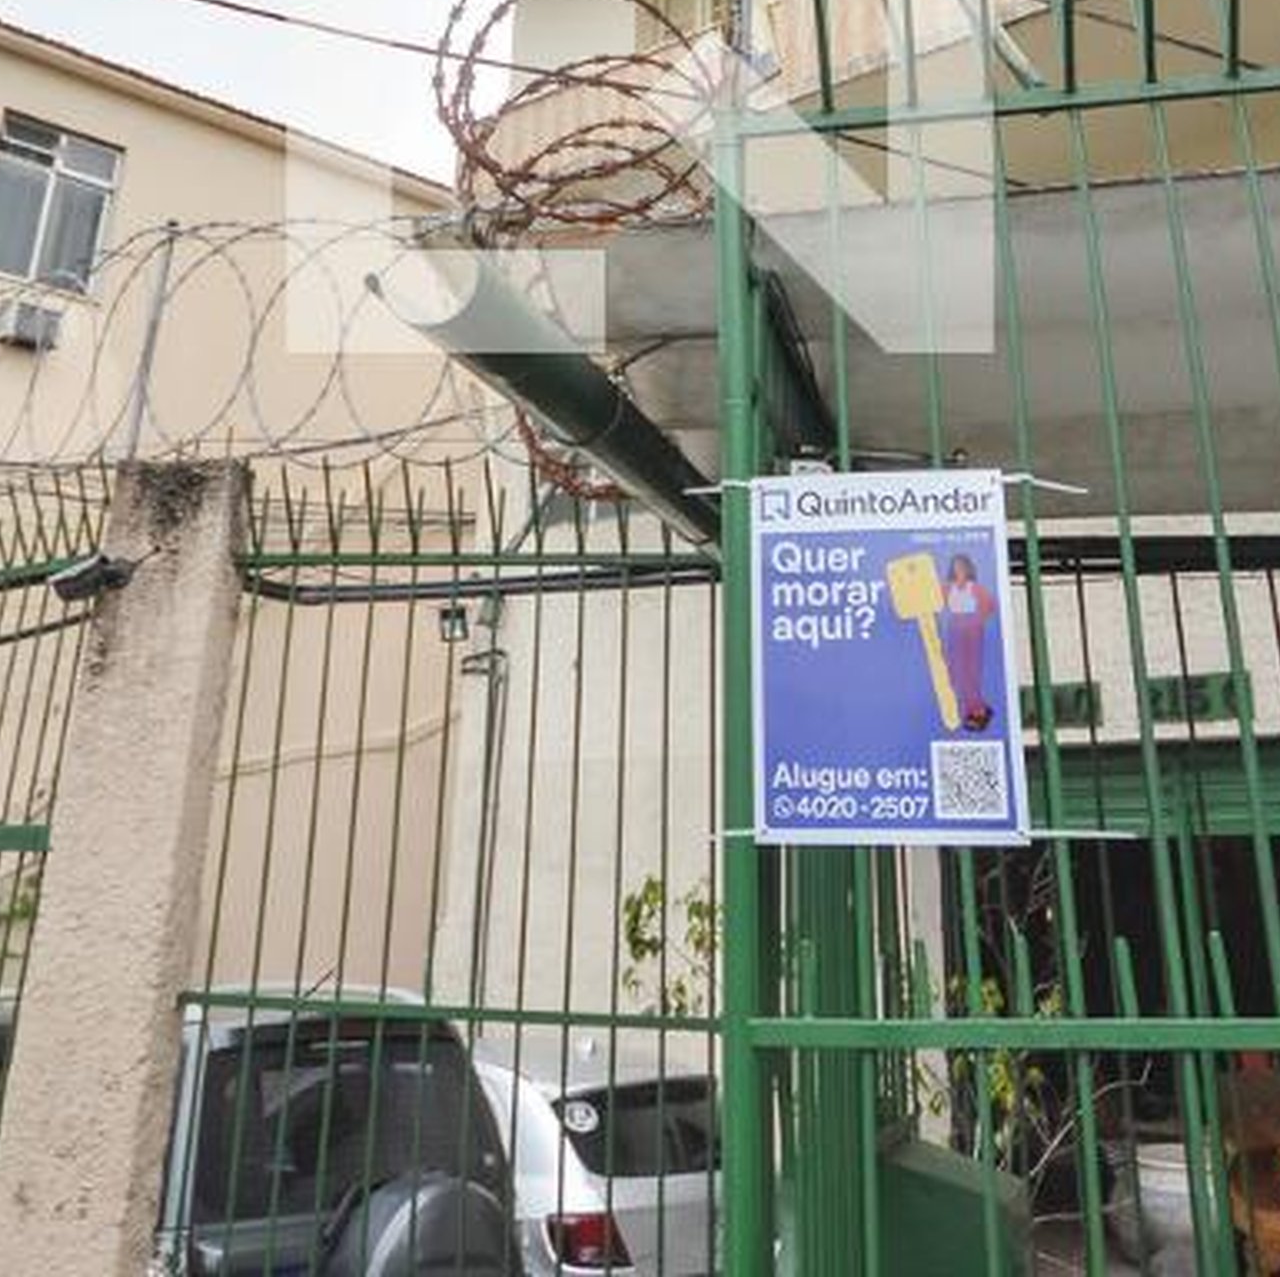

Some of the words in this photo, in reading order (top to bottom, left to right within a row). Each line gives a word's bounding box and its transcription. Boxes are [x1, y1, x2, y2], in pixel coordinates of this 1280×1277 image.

[797, 489, 993, 517] QuintoAndar
[773, 542, 866, 574] Quer
[773, 580, 884, 607] morar
[773, 607, 876, 648] aqui?
[773, 762, 870, 793] Alugue
[876, 766, 929, 790] em:
[797, 795, 929, 820] 4020-2507
